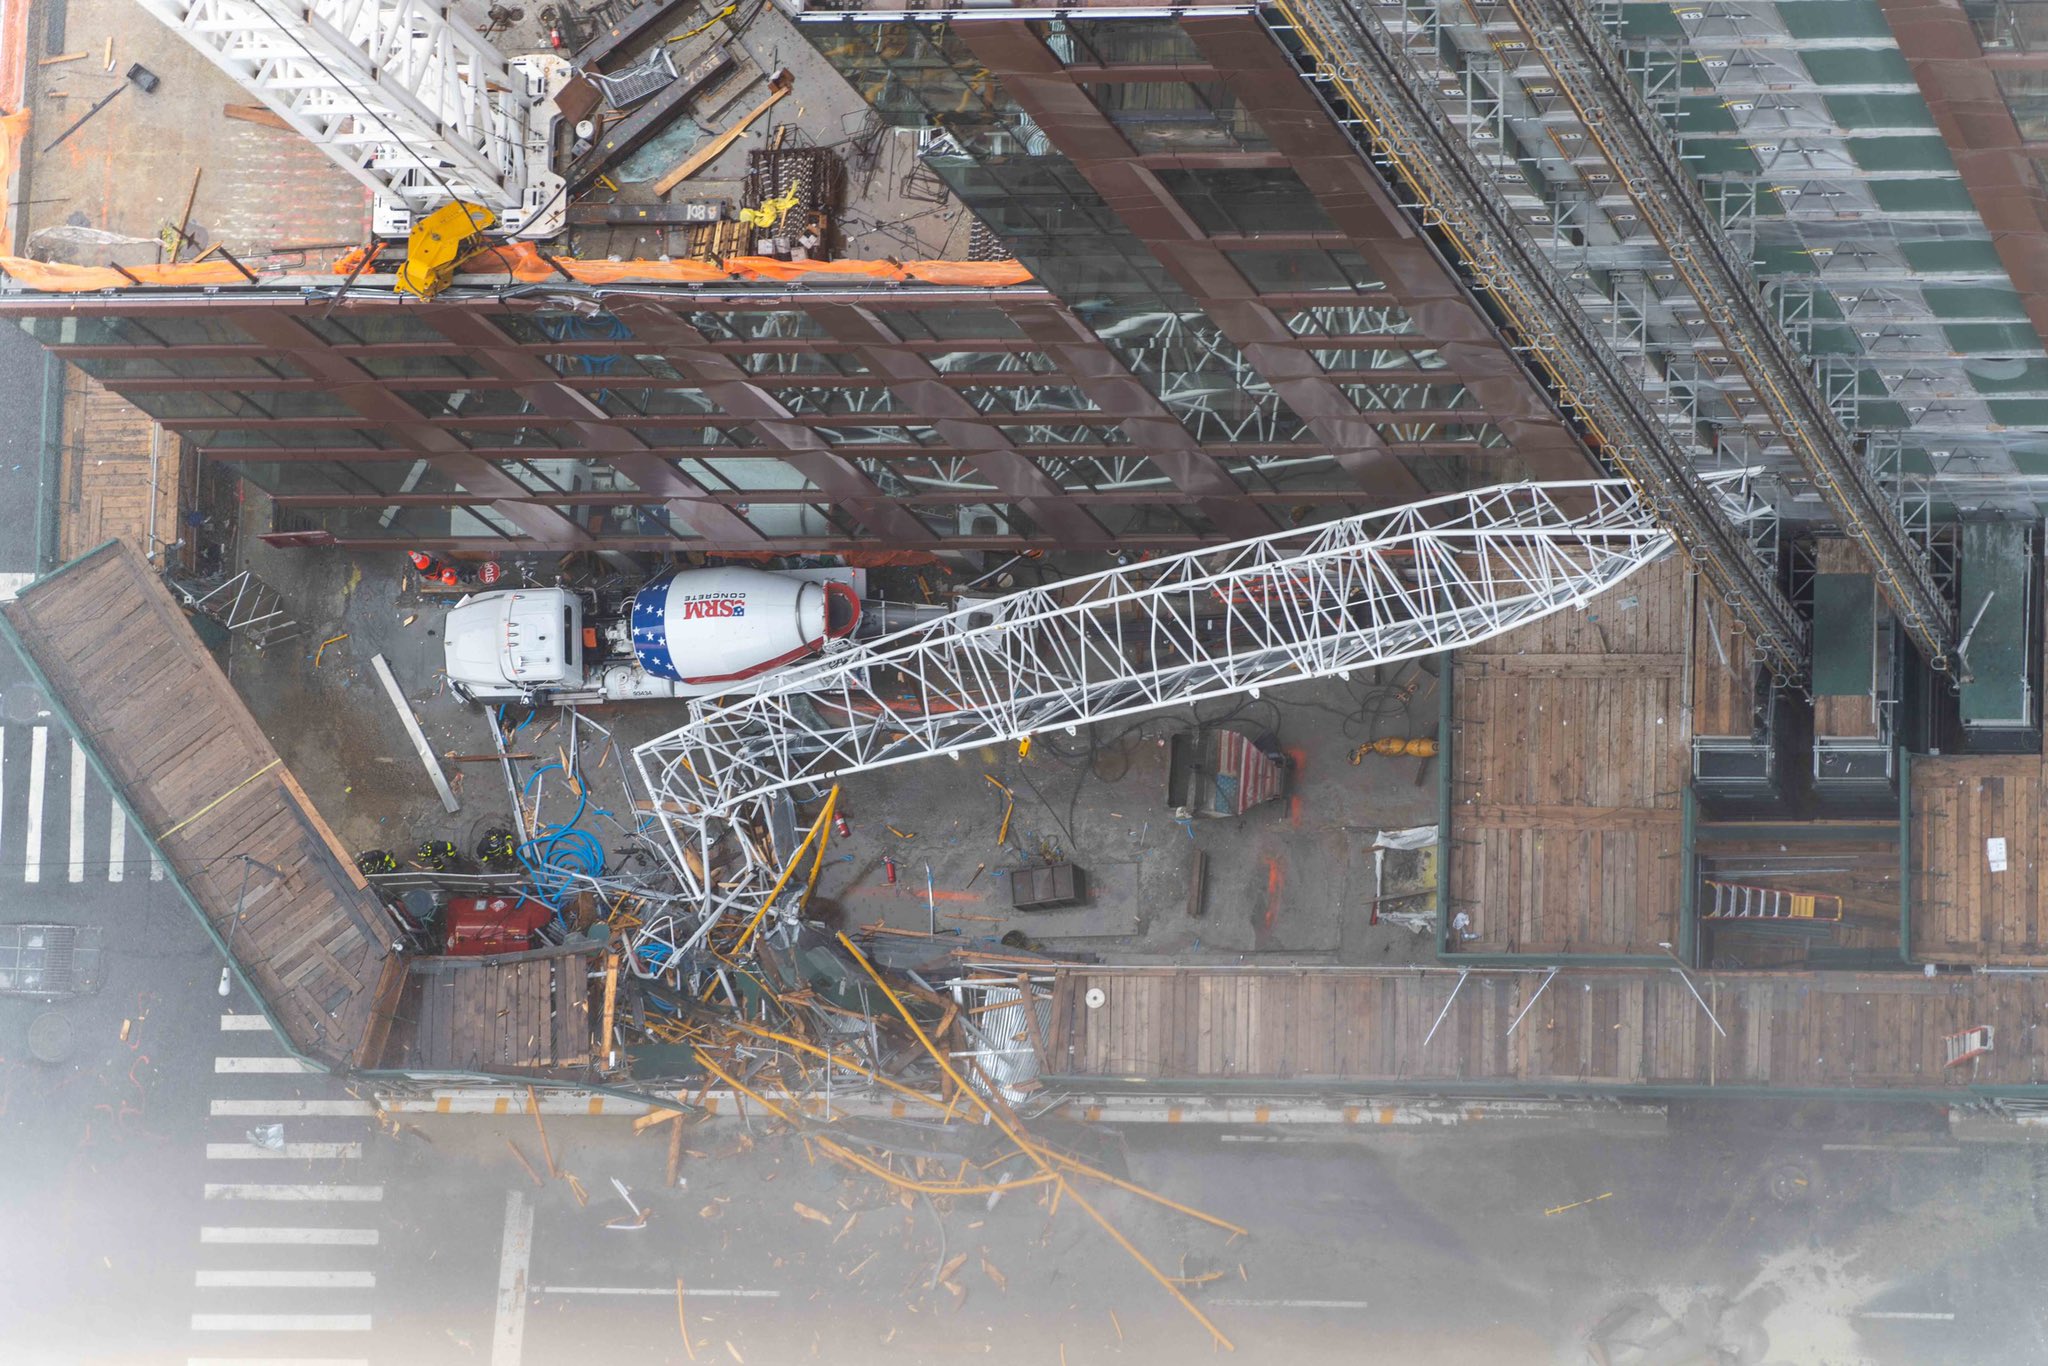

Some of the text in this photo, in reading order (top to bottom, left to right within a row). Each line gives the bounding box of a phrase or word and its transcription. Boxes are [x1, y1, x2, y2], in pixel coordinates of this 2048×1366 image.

[686, 203, 706, 221] 108
[484, 563, 495, 583] STOP
[685, 592, 746, 601] CONCRETE
[683, 599, 734, 620] SRM
